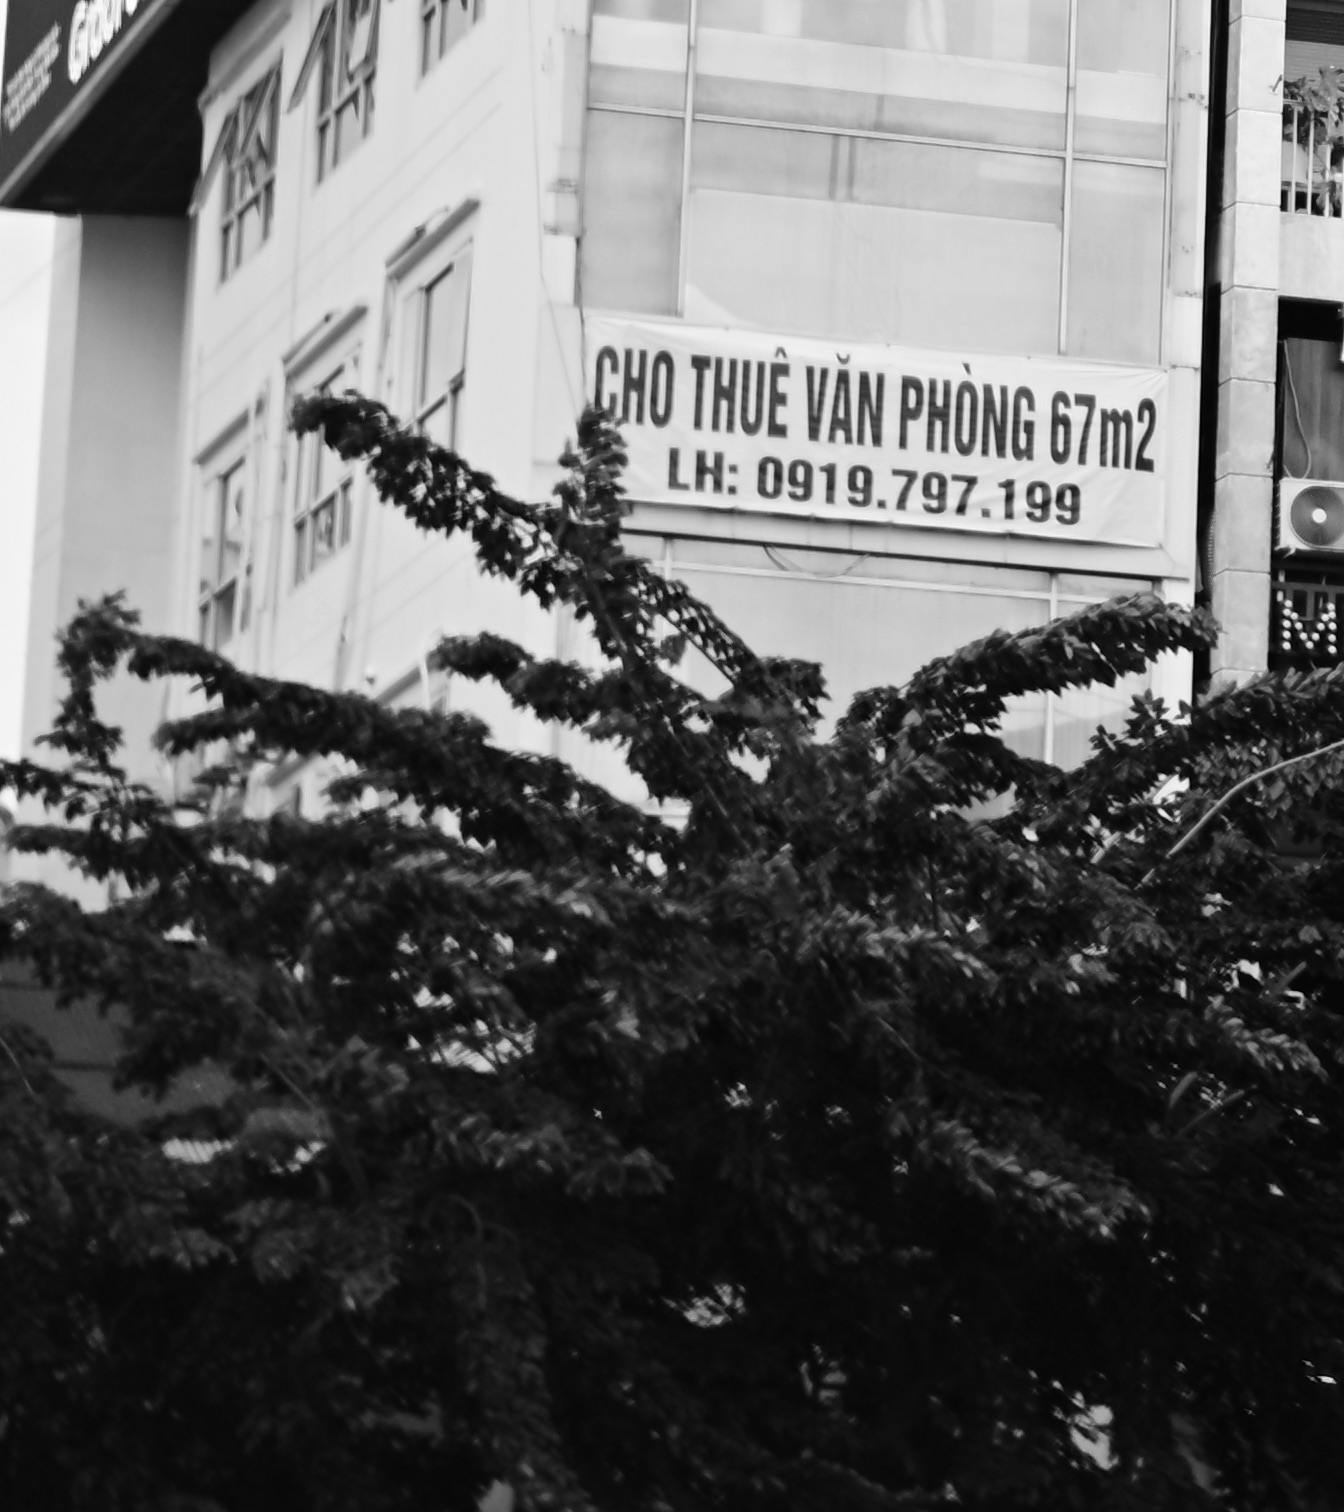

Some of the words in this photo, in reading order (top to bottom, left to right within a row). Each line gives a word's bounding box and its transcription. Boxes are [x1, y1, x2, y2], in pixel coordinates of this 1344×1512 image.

[594, 345, 676, 429] CHO
[690, 347, 790, 438] THUÊ
[805, 353, 884, 447] VĂN
[899, 363, 1036, 462] PHÒNG
[1050, 390, 1158, 473] 67m2
[668, 447, 738, 496] LH:
[756, 455, 1082, 526] 0919.797.199
